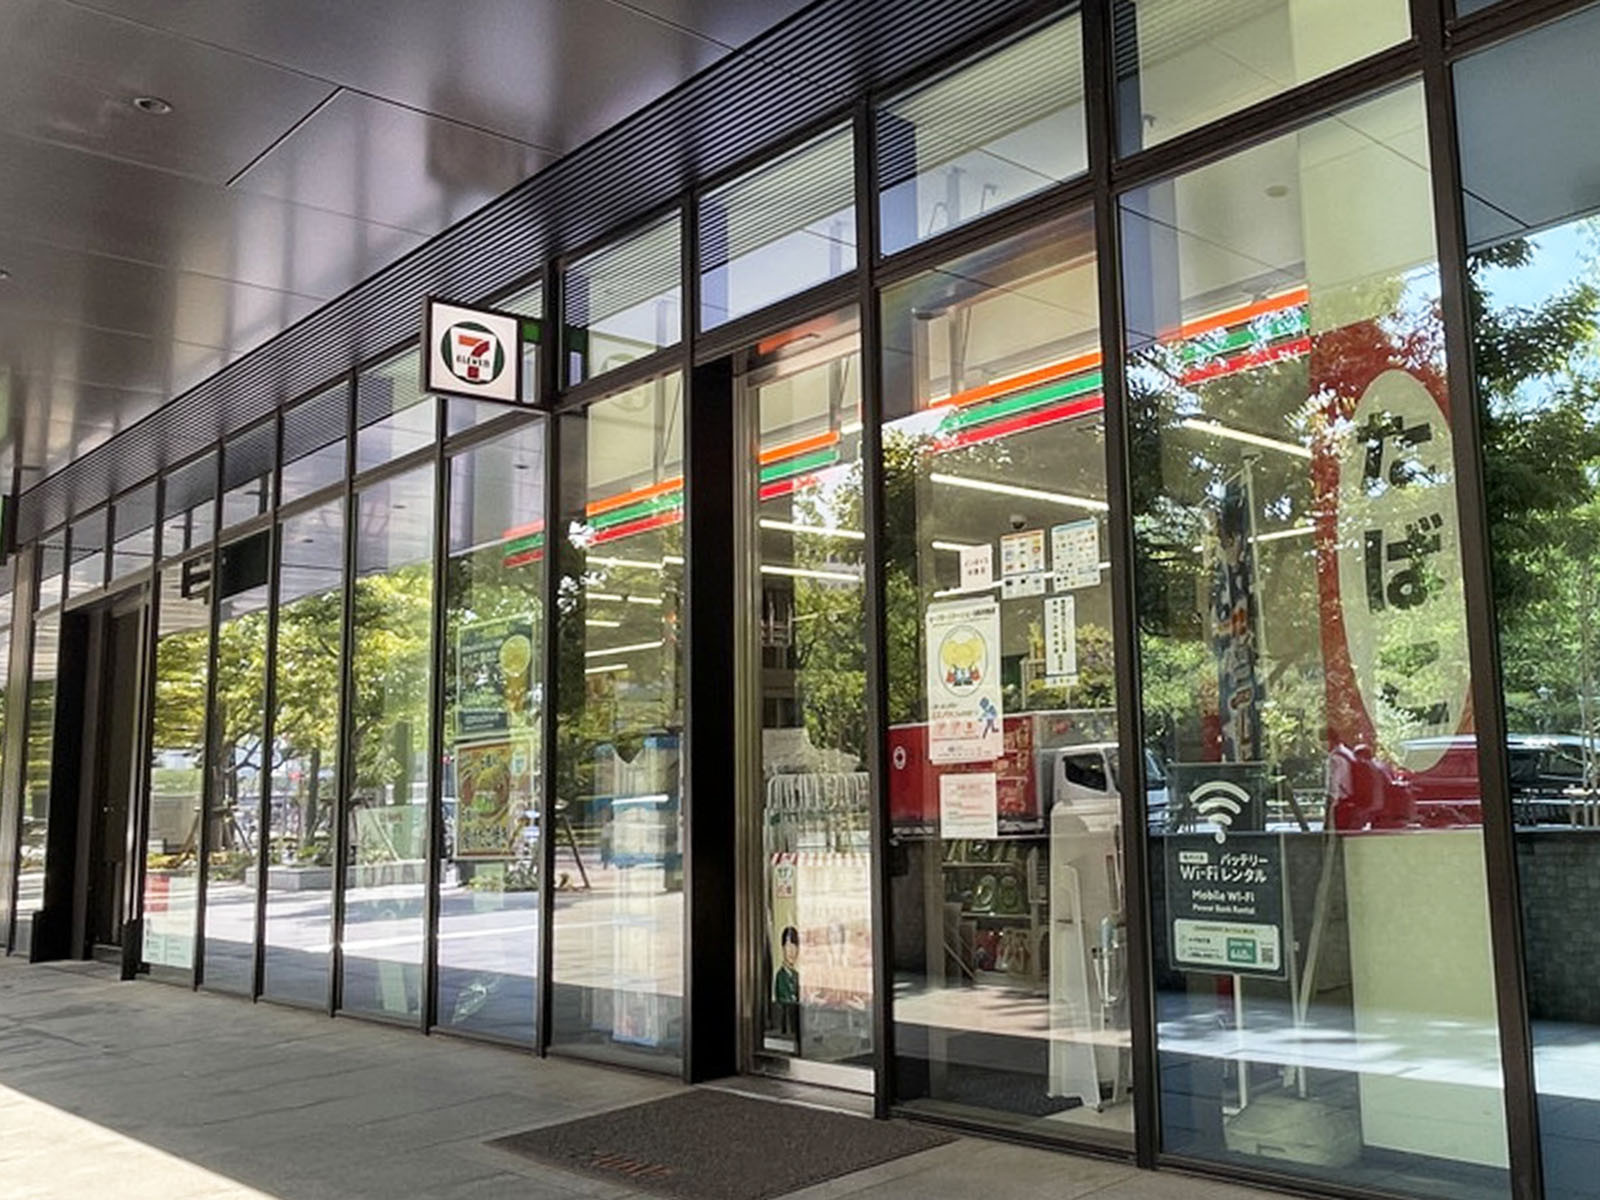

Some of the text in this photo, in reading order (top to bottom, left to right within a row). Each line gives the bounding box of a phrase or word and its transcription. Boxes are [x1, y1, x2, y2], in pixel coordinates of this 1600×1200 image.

[458, 335, 490, 378] 7
[1221, 853, 1269, 866] バッテリー
[1179, 865, 1267, 883] Wi-Fi レンタル
[1192, 889, 1255, 902] Mobile Wi-Fi
